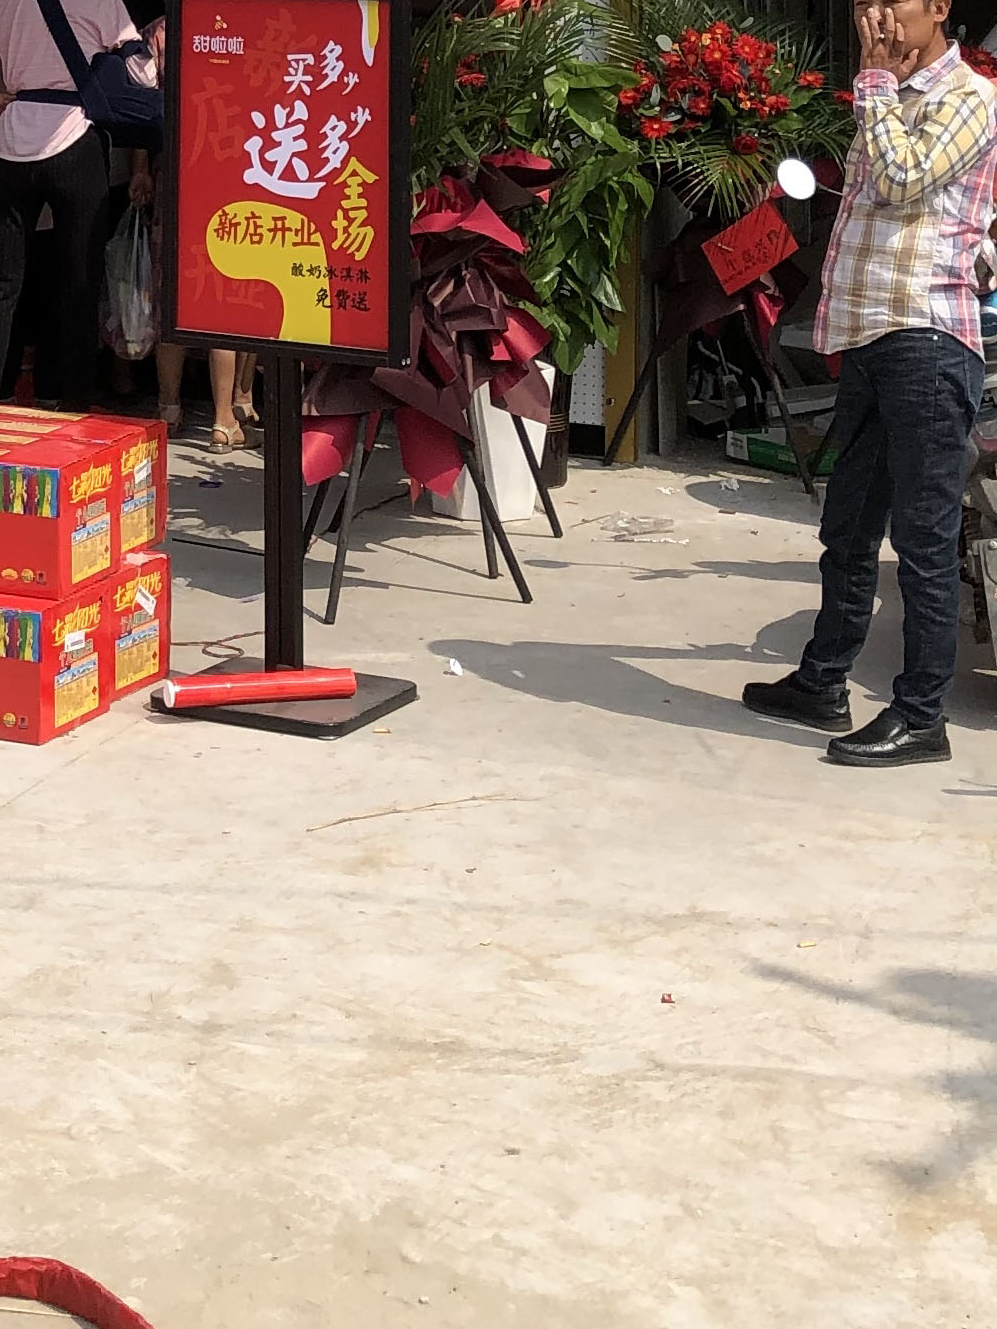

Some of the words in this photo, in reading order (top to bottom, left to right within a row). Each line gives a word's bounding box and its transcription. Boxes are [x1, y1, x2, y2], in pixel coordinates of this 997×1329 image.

[193, 35, 245, 55] 甜啦啦
[283, 40, 360, 96] 买多少
[243, 100, 372, 199] 送多少
[214, 208, 320, 248] 新店开业
[331, 157, 379, 261] 全场
[291, 263, 371, 284] 酸奶冰淇淋
[315, 287, 371, 311] 免费送
